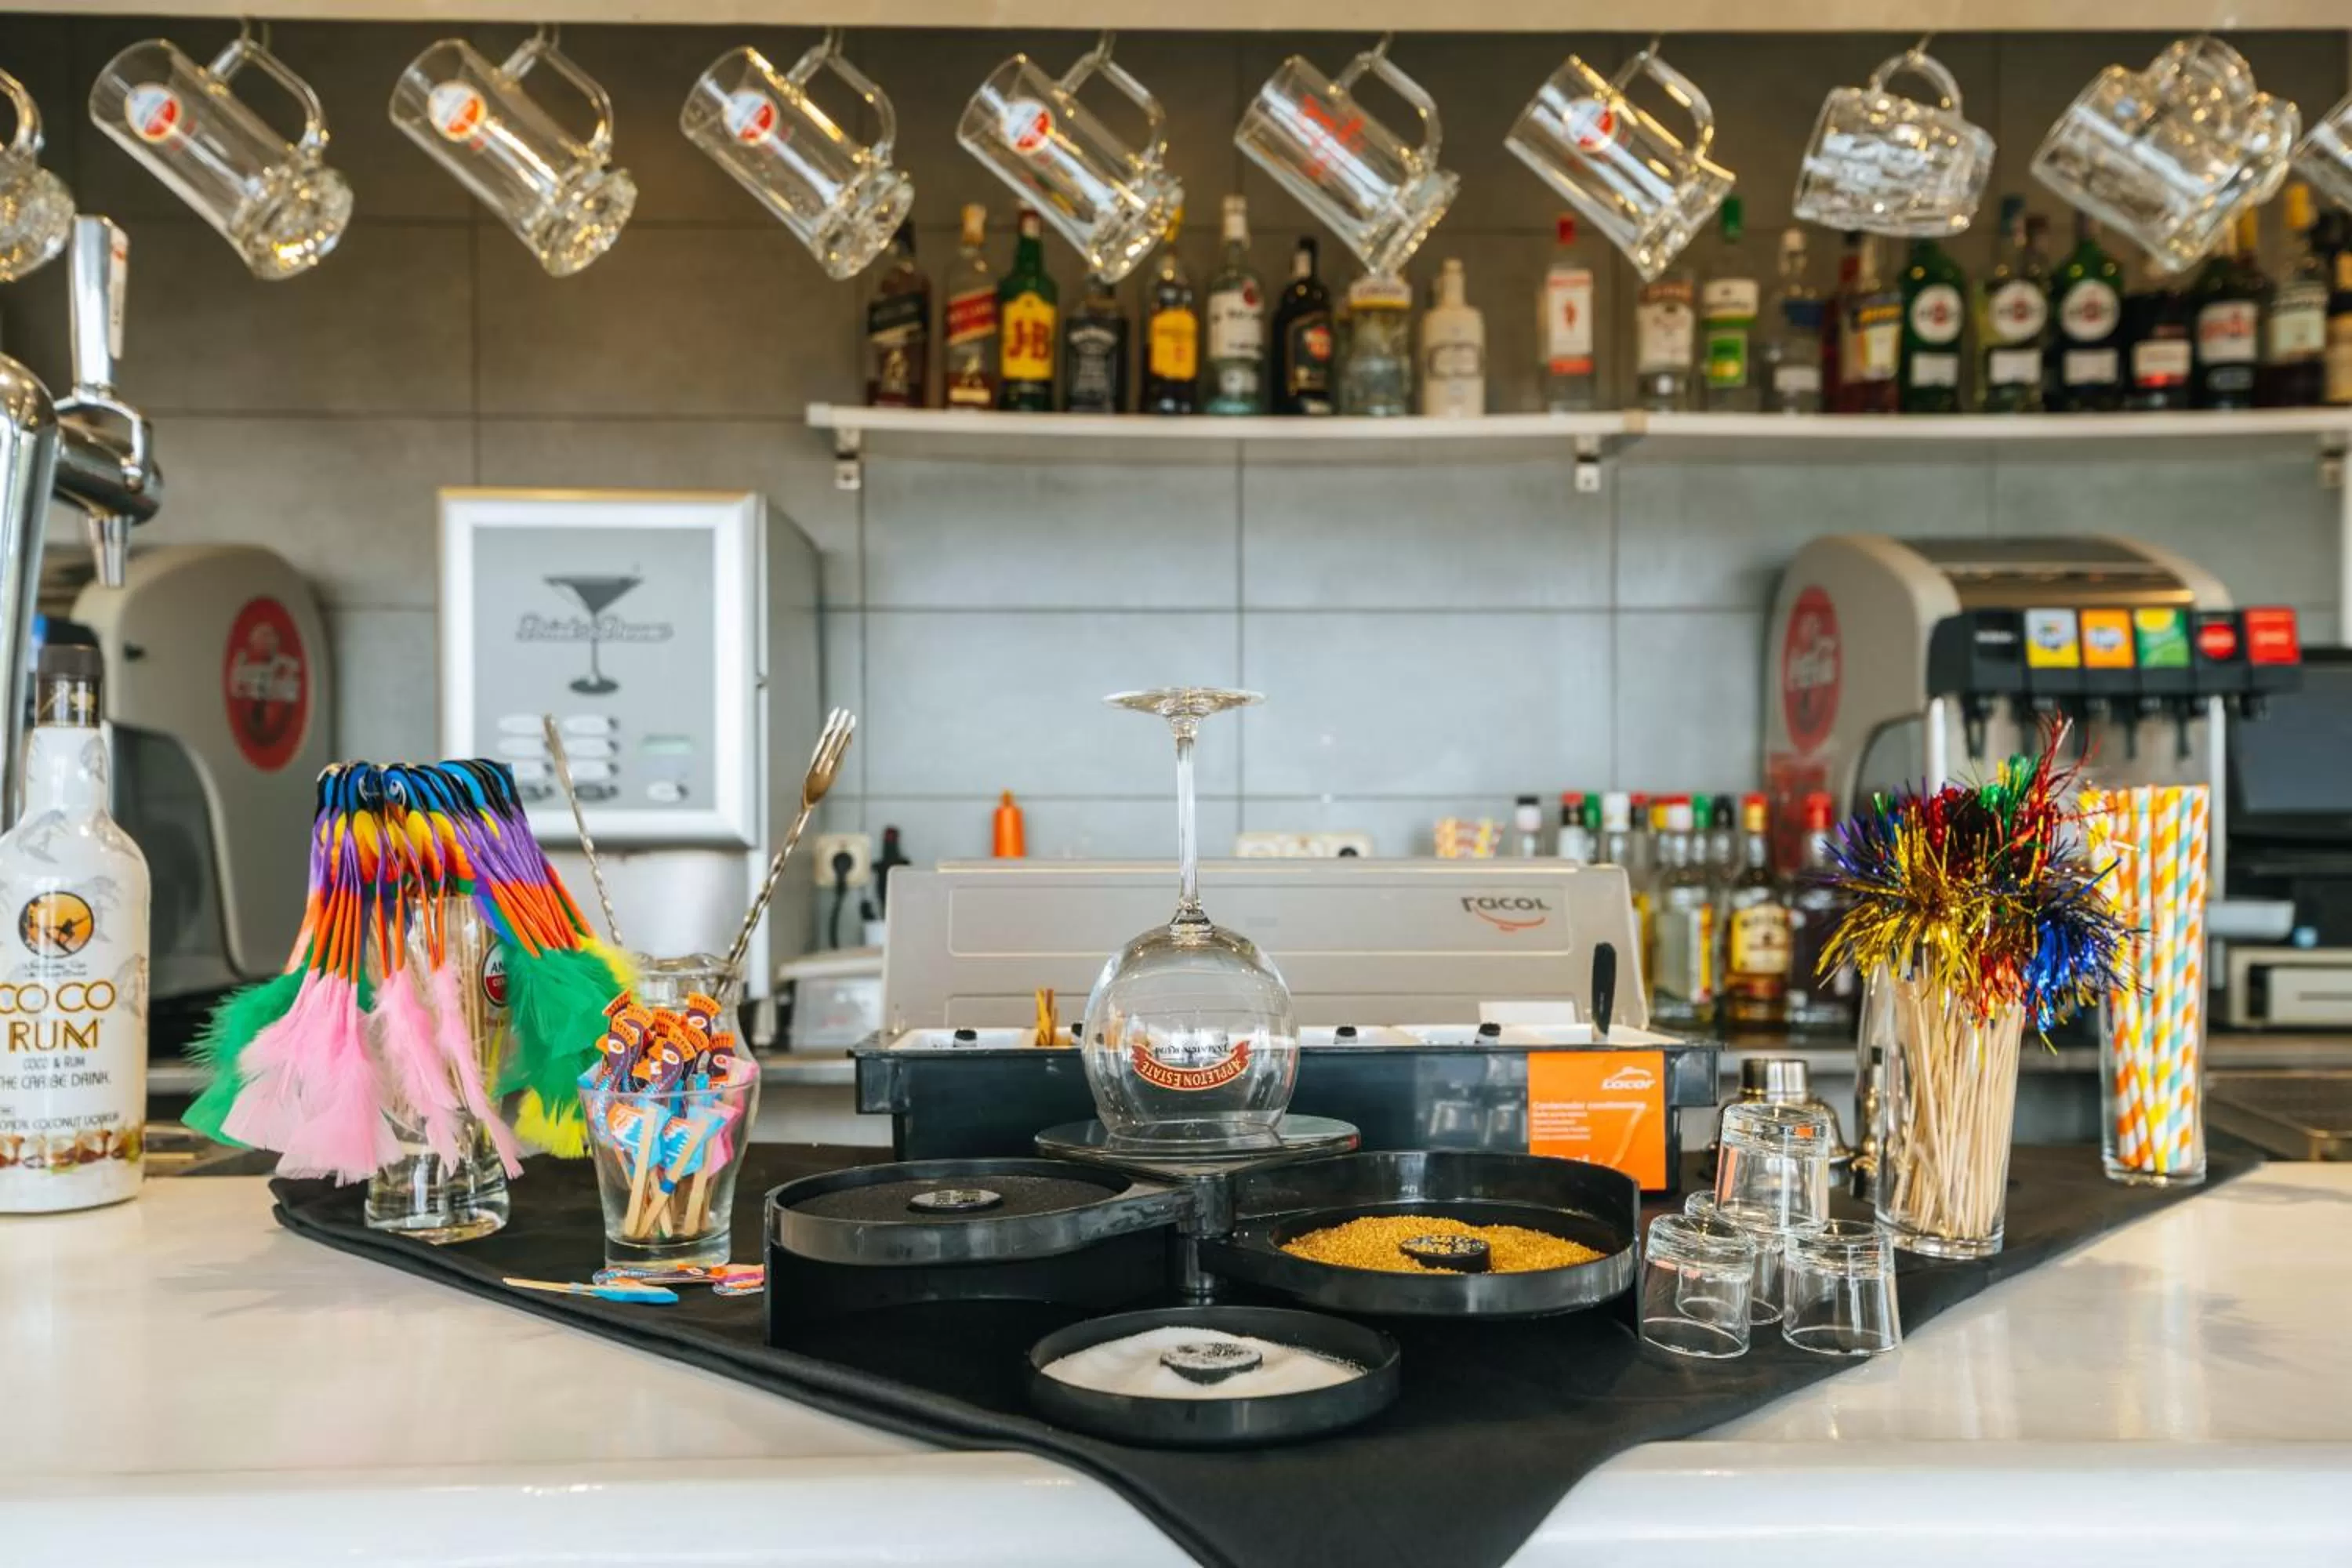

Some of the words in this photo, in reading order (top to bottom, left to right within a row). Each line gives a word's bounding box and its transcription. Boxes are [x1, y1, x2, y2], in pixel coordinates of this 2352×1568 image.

[9, 1018, 99, 1054] RUM
[20, 1073, 67, 1090] CARBE
[1140, 1060, 1181, 1087] ESTATE
[1183, 1057, 1242, 1087] APPLETON
